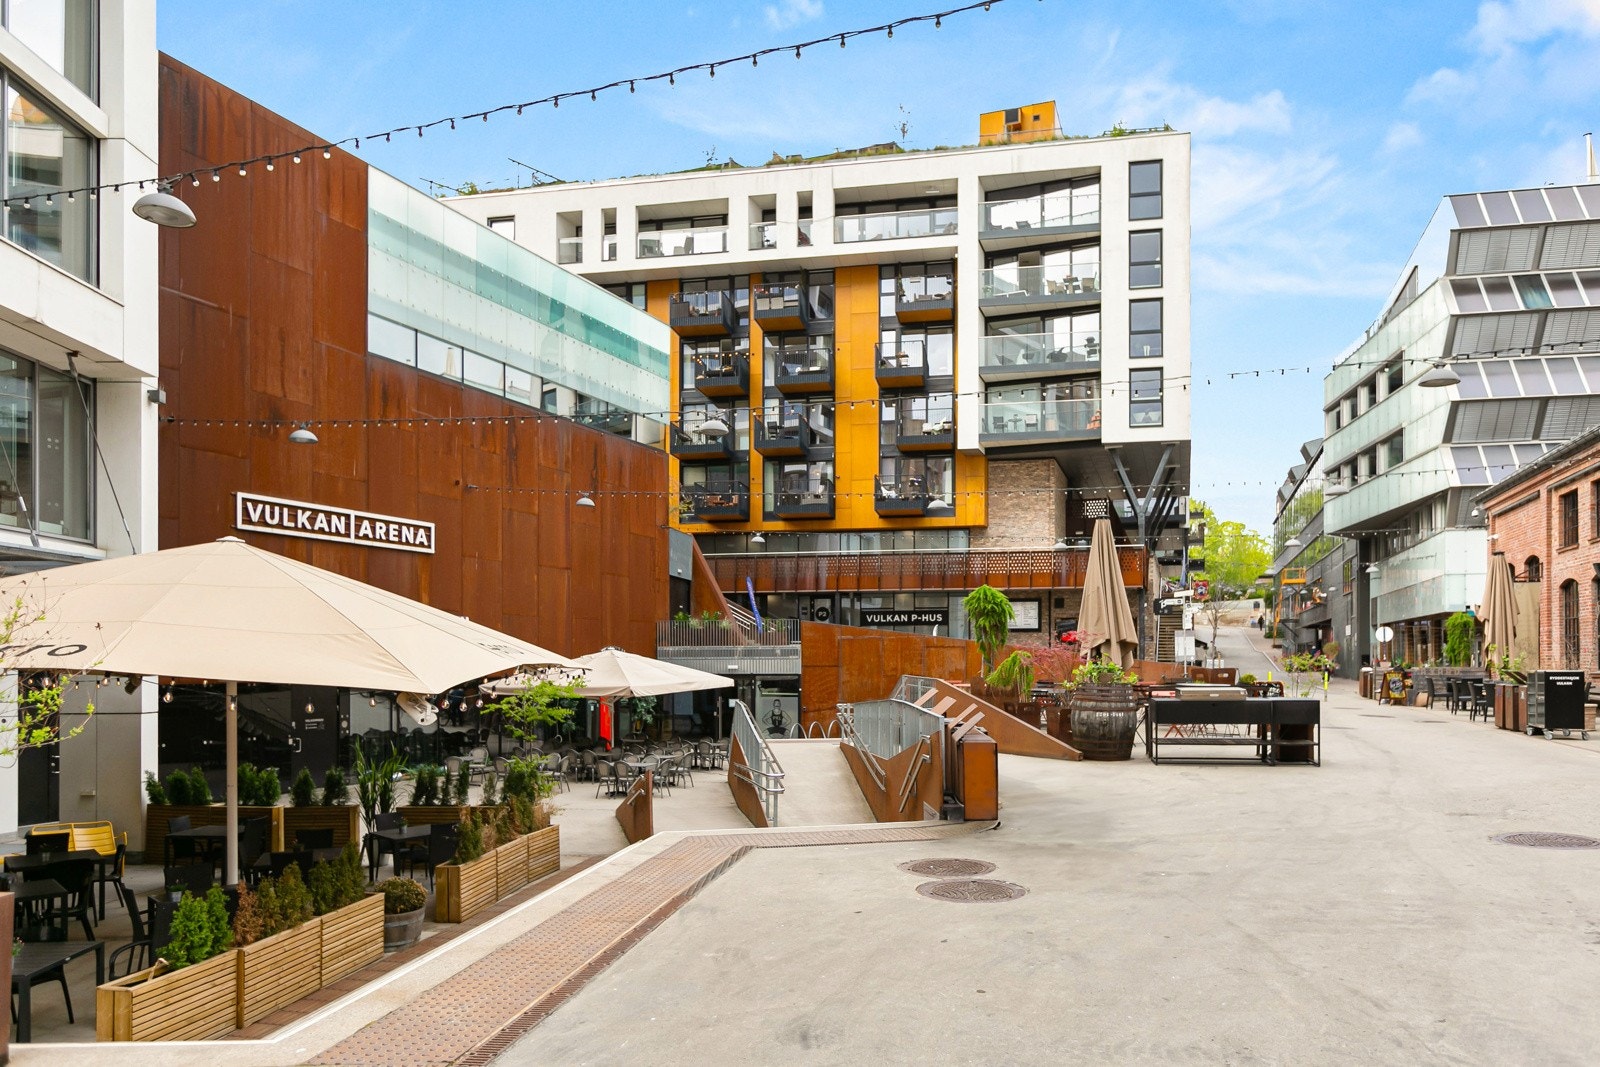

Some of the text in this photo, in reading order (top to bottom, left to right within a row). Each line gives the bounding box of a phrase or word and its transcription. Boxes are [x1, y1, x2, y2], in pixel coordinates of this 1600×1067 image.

[246, 502, 429, 546] VULKAN ARENA
[866, 614, 943, 622] VULKAN P-HUS
